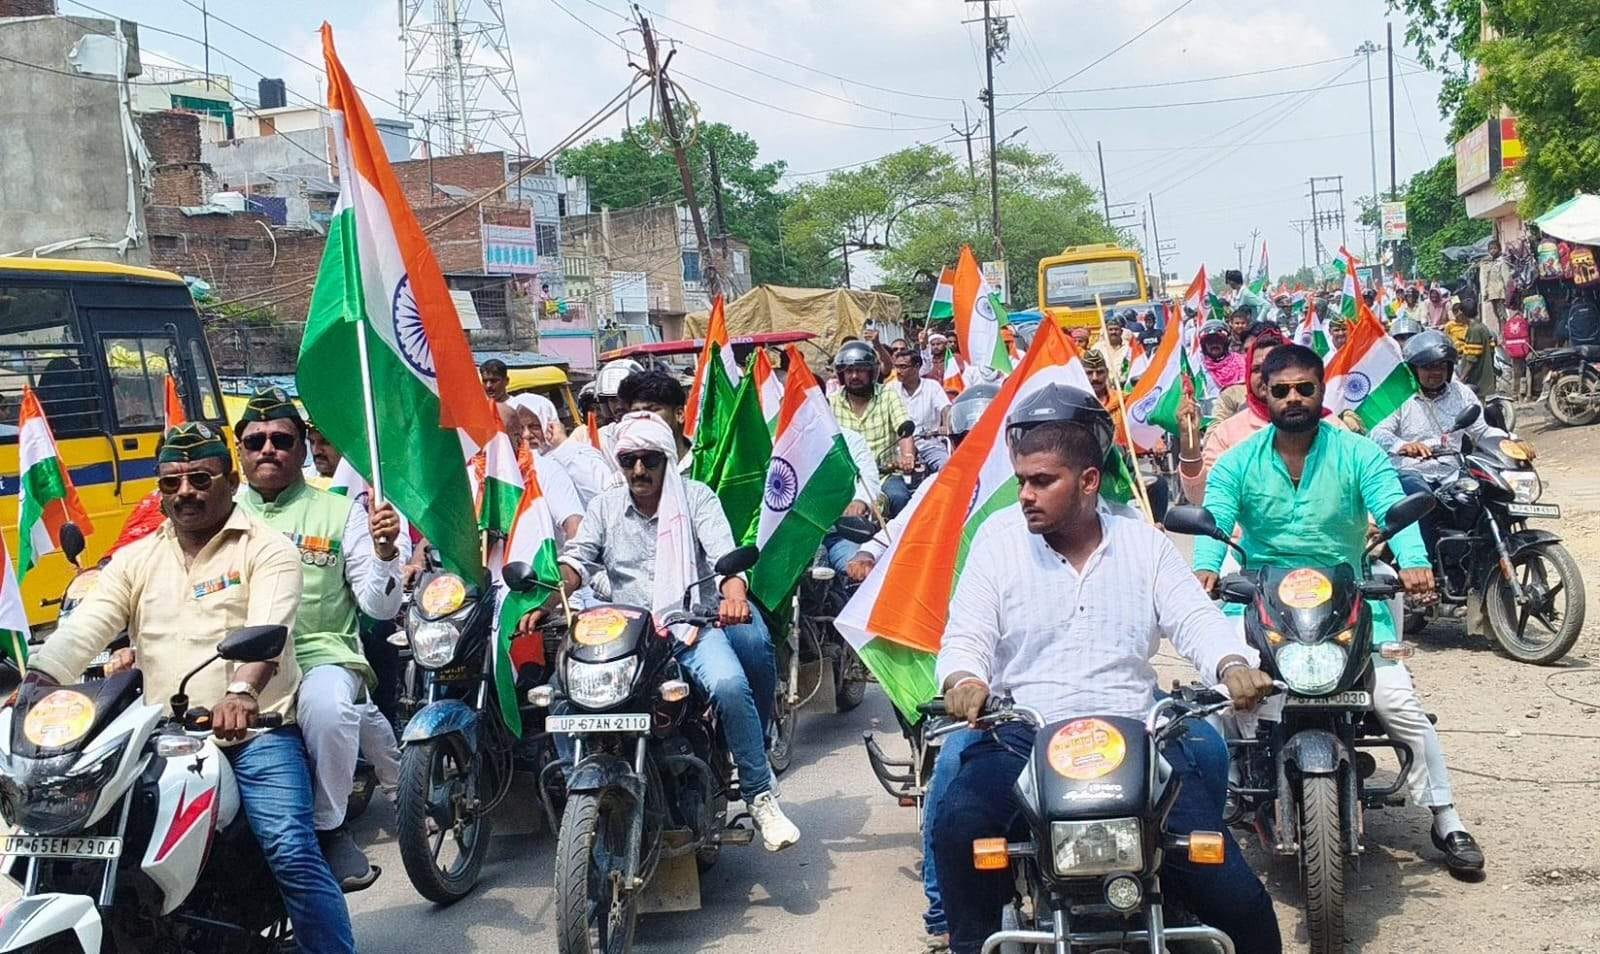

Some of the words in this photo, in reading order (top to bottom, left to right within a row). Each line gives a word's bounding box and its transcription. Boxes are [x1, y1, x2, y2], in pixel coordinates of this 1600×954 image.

[560, 718, 576, 730] UP
[580, 718, 610, 730] 67AN
[616, 717, 647, 729] 2110
[5, 838, 24, 853] UP
[30, 838, 69, 854] 65EM
[76, 839, 116, 855] 2904
